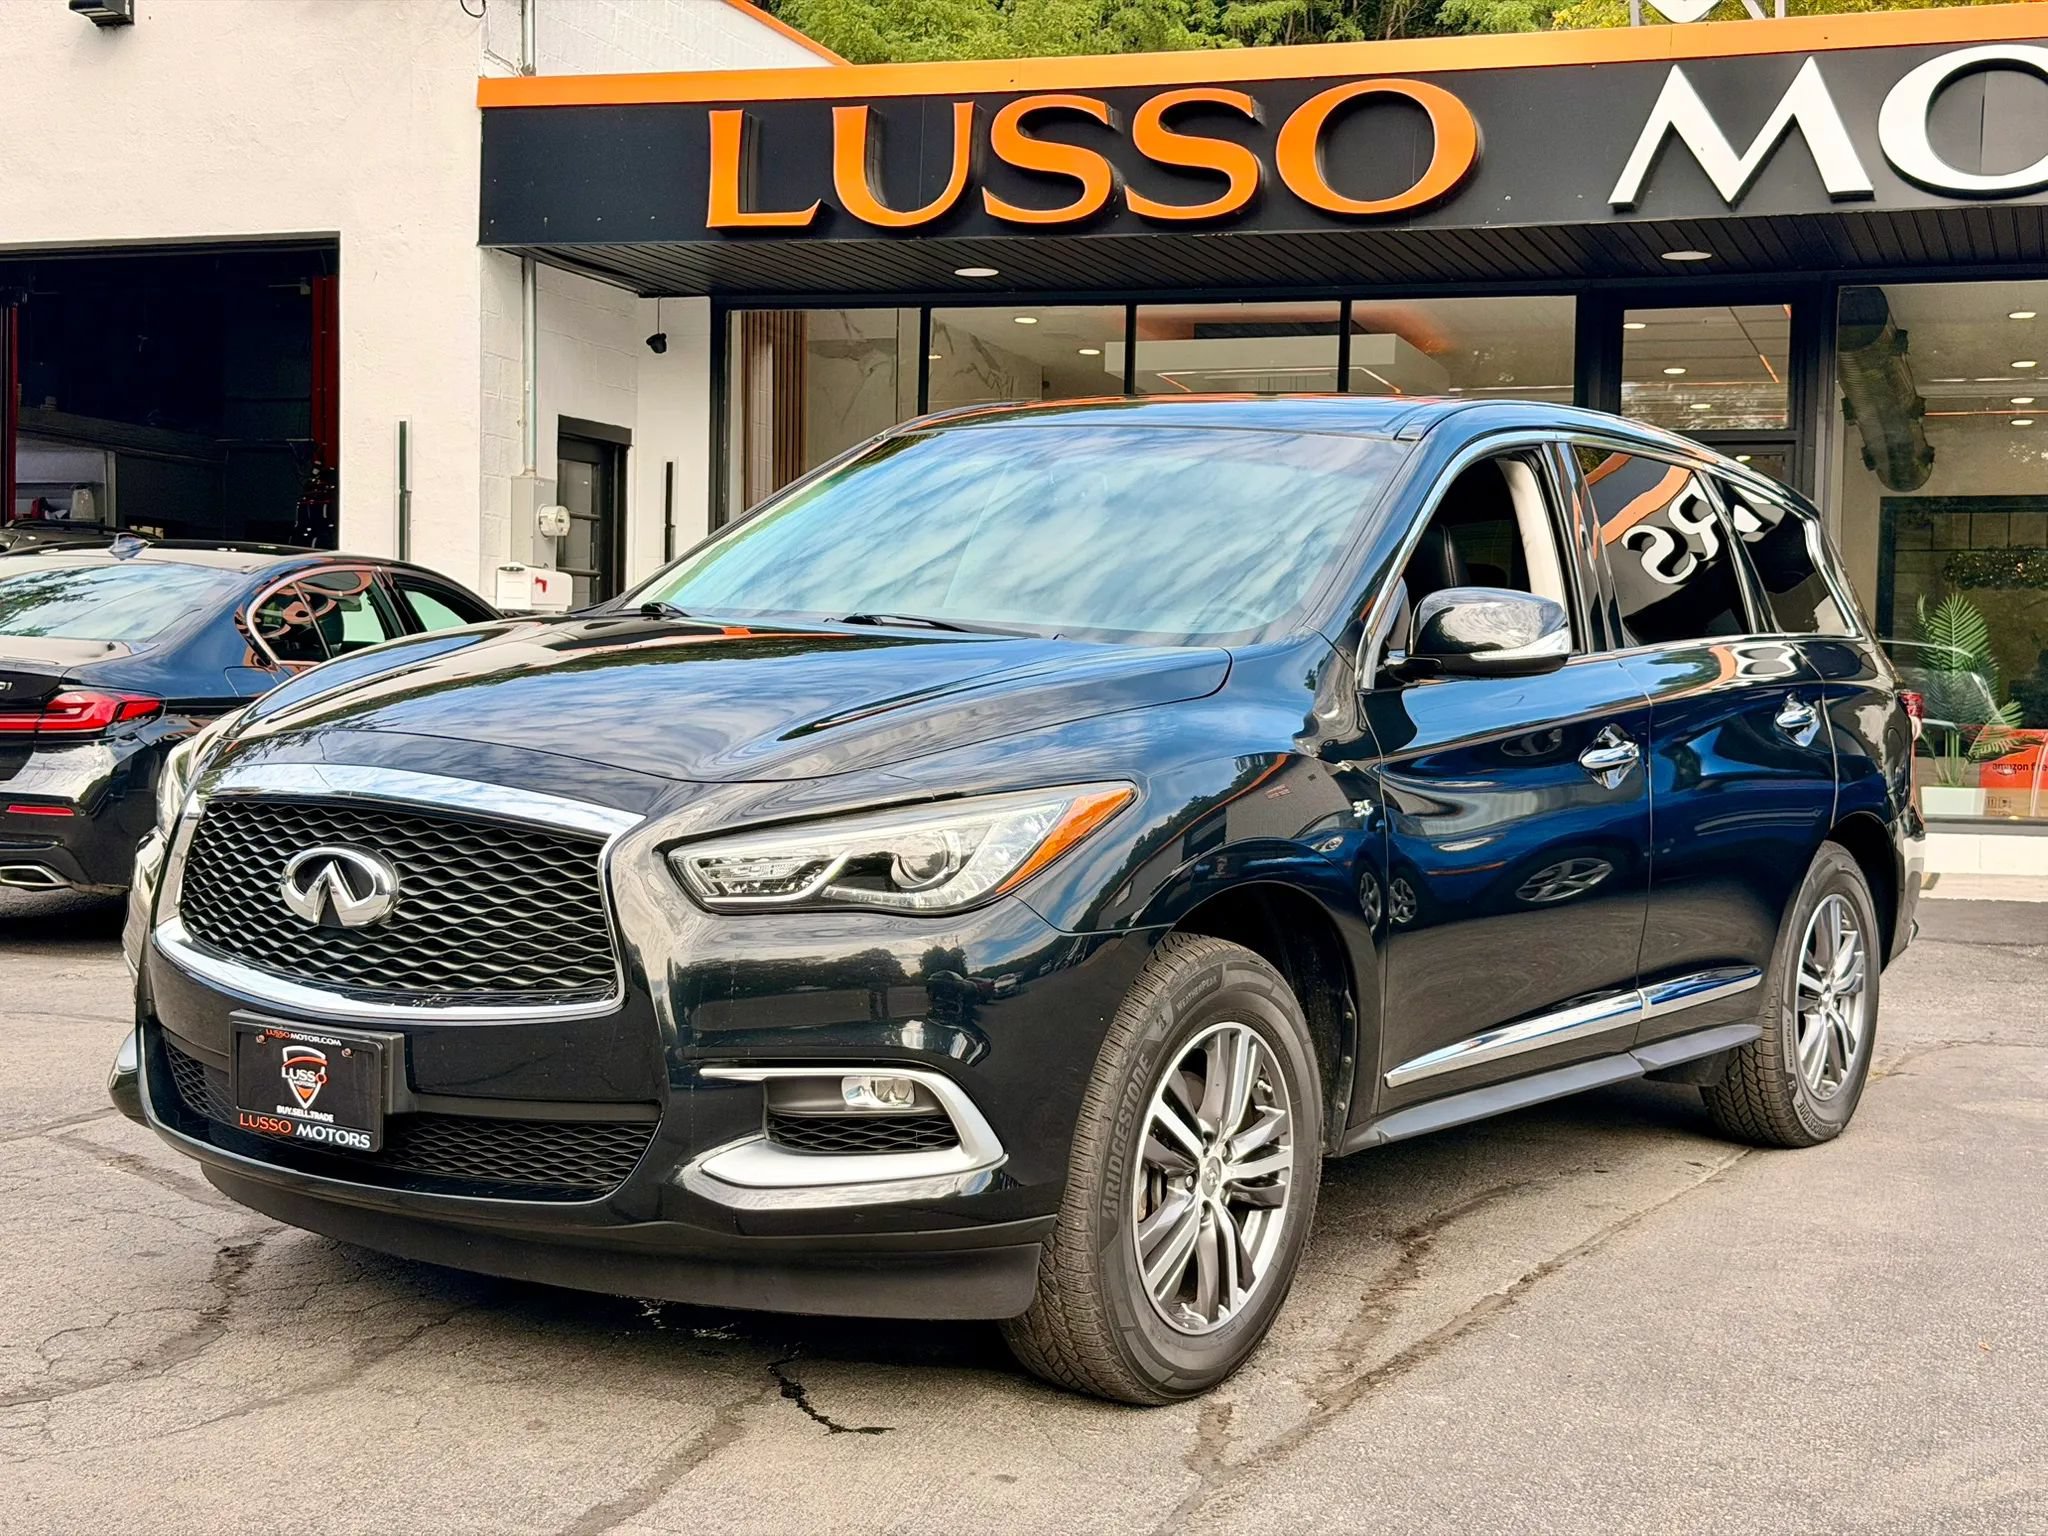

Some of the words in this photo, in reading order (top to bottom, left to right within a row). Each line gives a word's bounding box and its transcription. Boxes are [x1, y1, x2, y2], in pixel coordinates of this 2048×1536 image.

[706, 77, 1480, 231] LUSSO
[1608, 44, 2048, 211] MO
[281, 1067, 328, 1085] LUSSO
[239, 1113, 292, 1134] LUSSO
[296, 1123, 371, 1149] MOTORS
